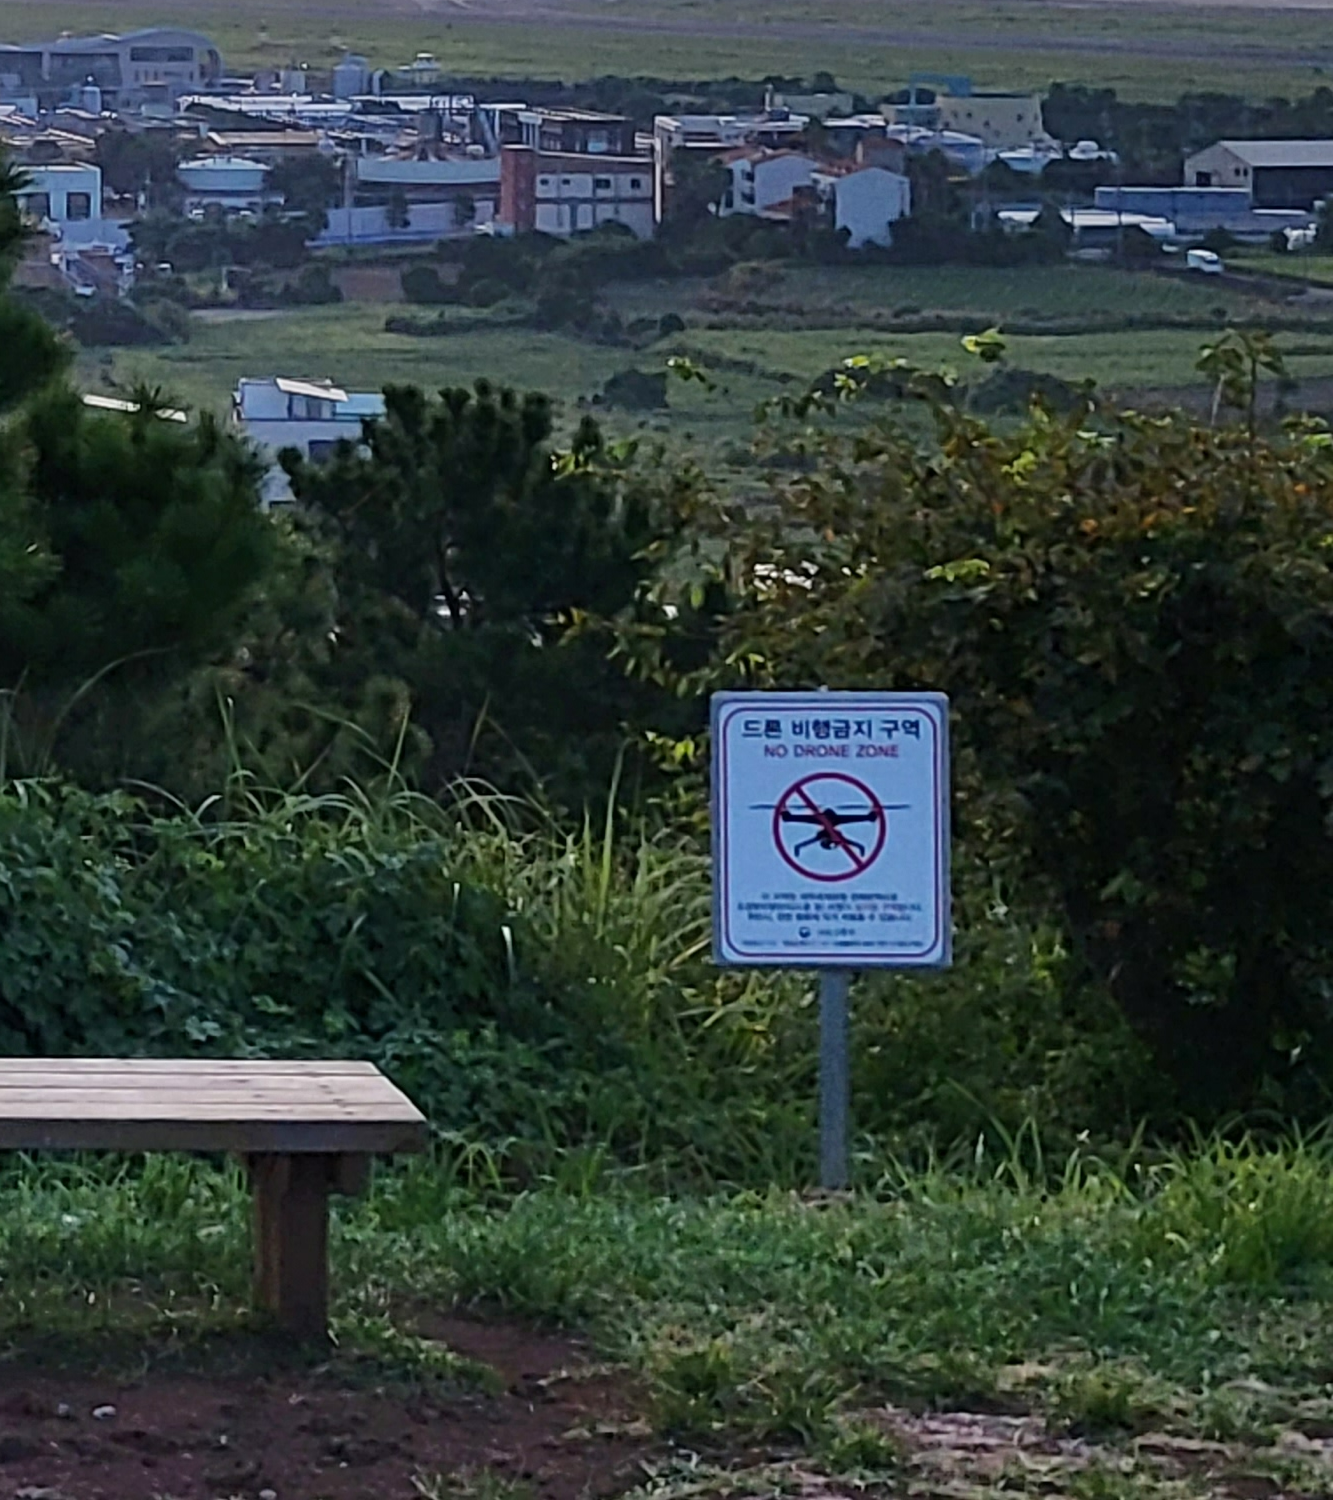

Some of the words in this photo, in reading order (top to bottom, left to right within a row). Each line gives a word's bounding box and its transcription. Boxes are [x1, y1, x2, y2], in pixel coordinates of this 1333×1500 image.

[742, 719, 782, 739] 드론
[792, 719, 872, 740] 비행금지
[880, 719, 921, 740] 구역
[764, 744, 788, 758] NO
[794, 744, 850, 758] DRONE
[855, 744, 899, 758] ZONE
